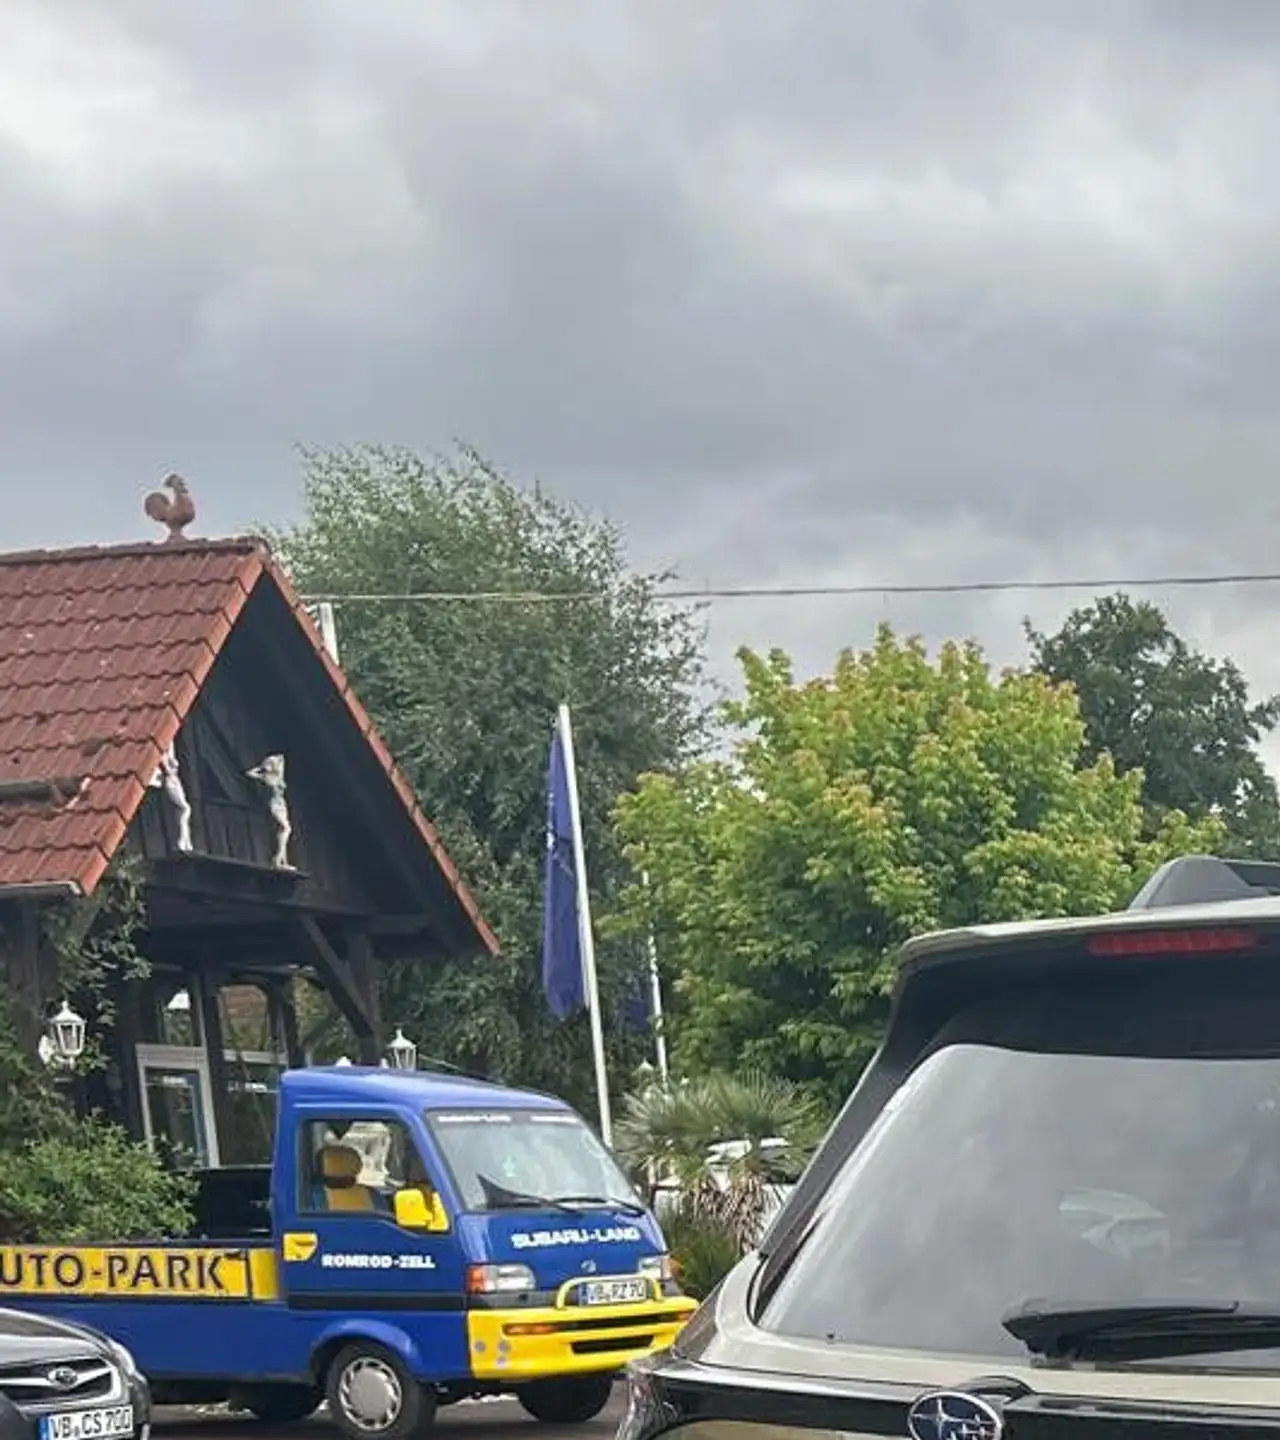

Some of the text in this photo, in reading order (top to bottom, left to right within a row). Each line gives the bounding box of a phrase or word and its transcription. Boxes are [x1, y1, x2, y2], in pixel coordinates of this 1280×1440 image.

[510, 1226, 642, 1249] SUBARU-LAND
[321, 1254, 436, 1269] ROMROD-ZELL
[49, 1408, 131, 1439] VB CS 700
